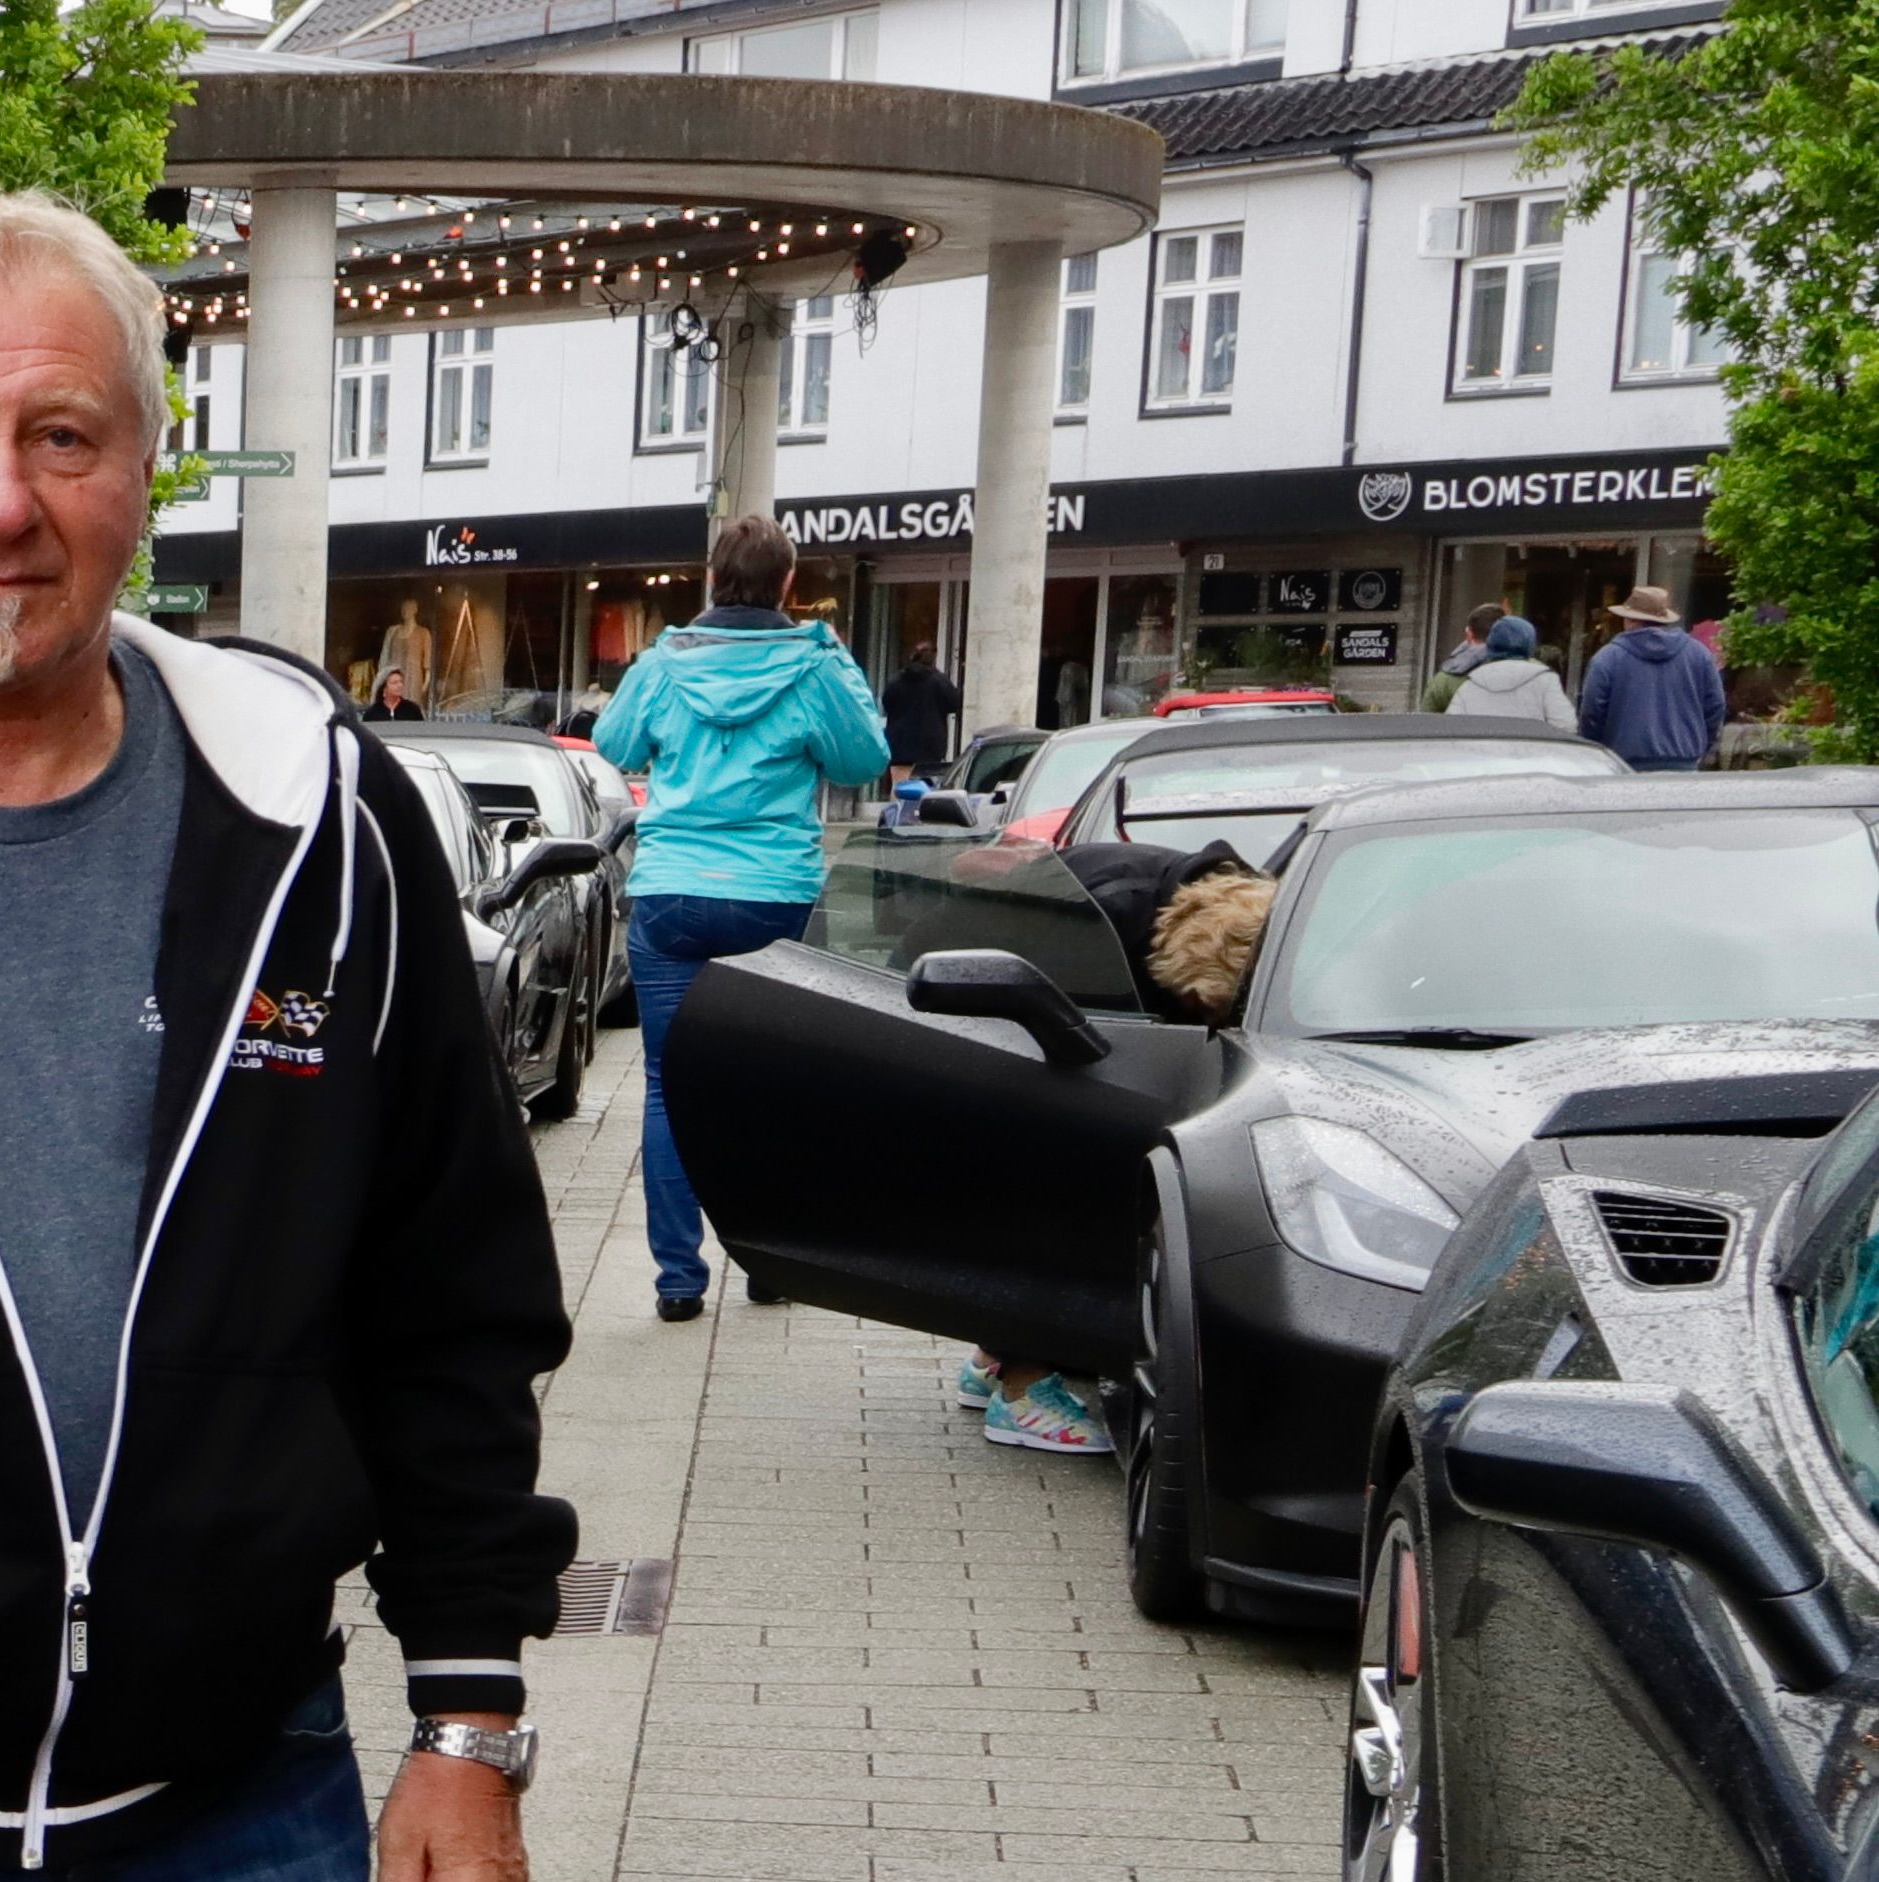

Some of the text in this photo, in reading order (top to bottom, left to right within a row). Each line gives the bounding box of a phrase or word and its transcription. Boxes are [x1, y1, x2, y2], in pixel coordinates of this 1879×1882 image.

[425, 524, 472, 566] Nais
[229, 1056, 264, 1069] LUB
[232, 1038, 324, 1064] ORVETTE
